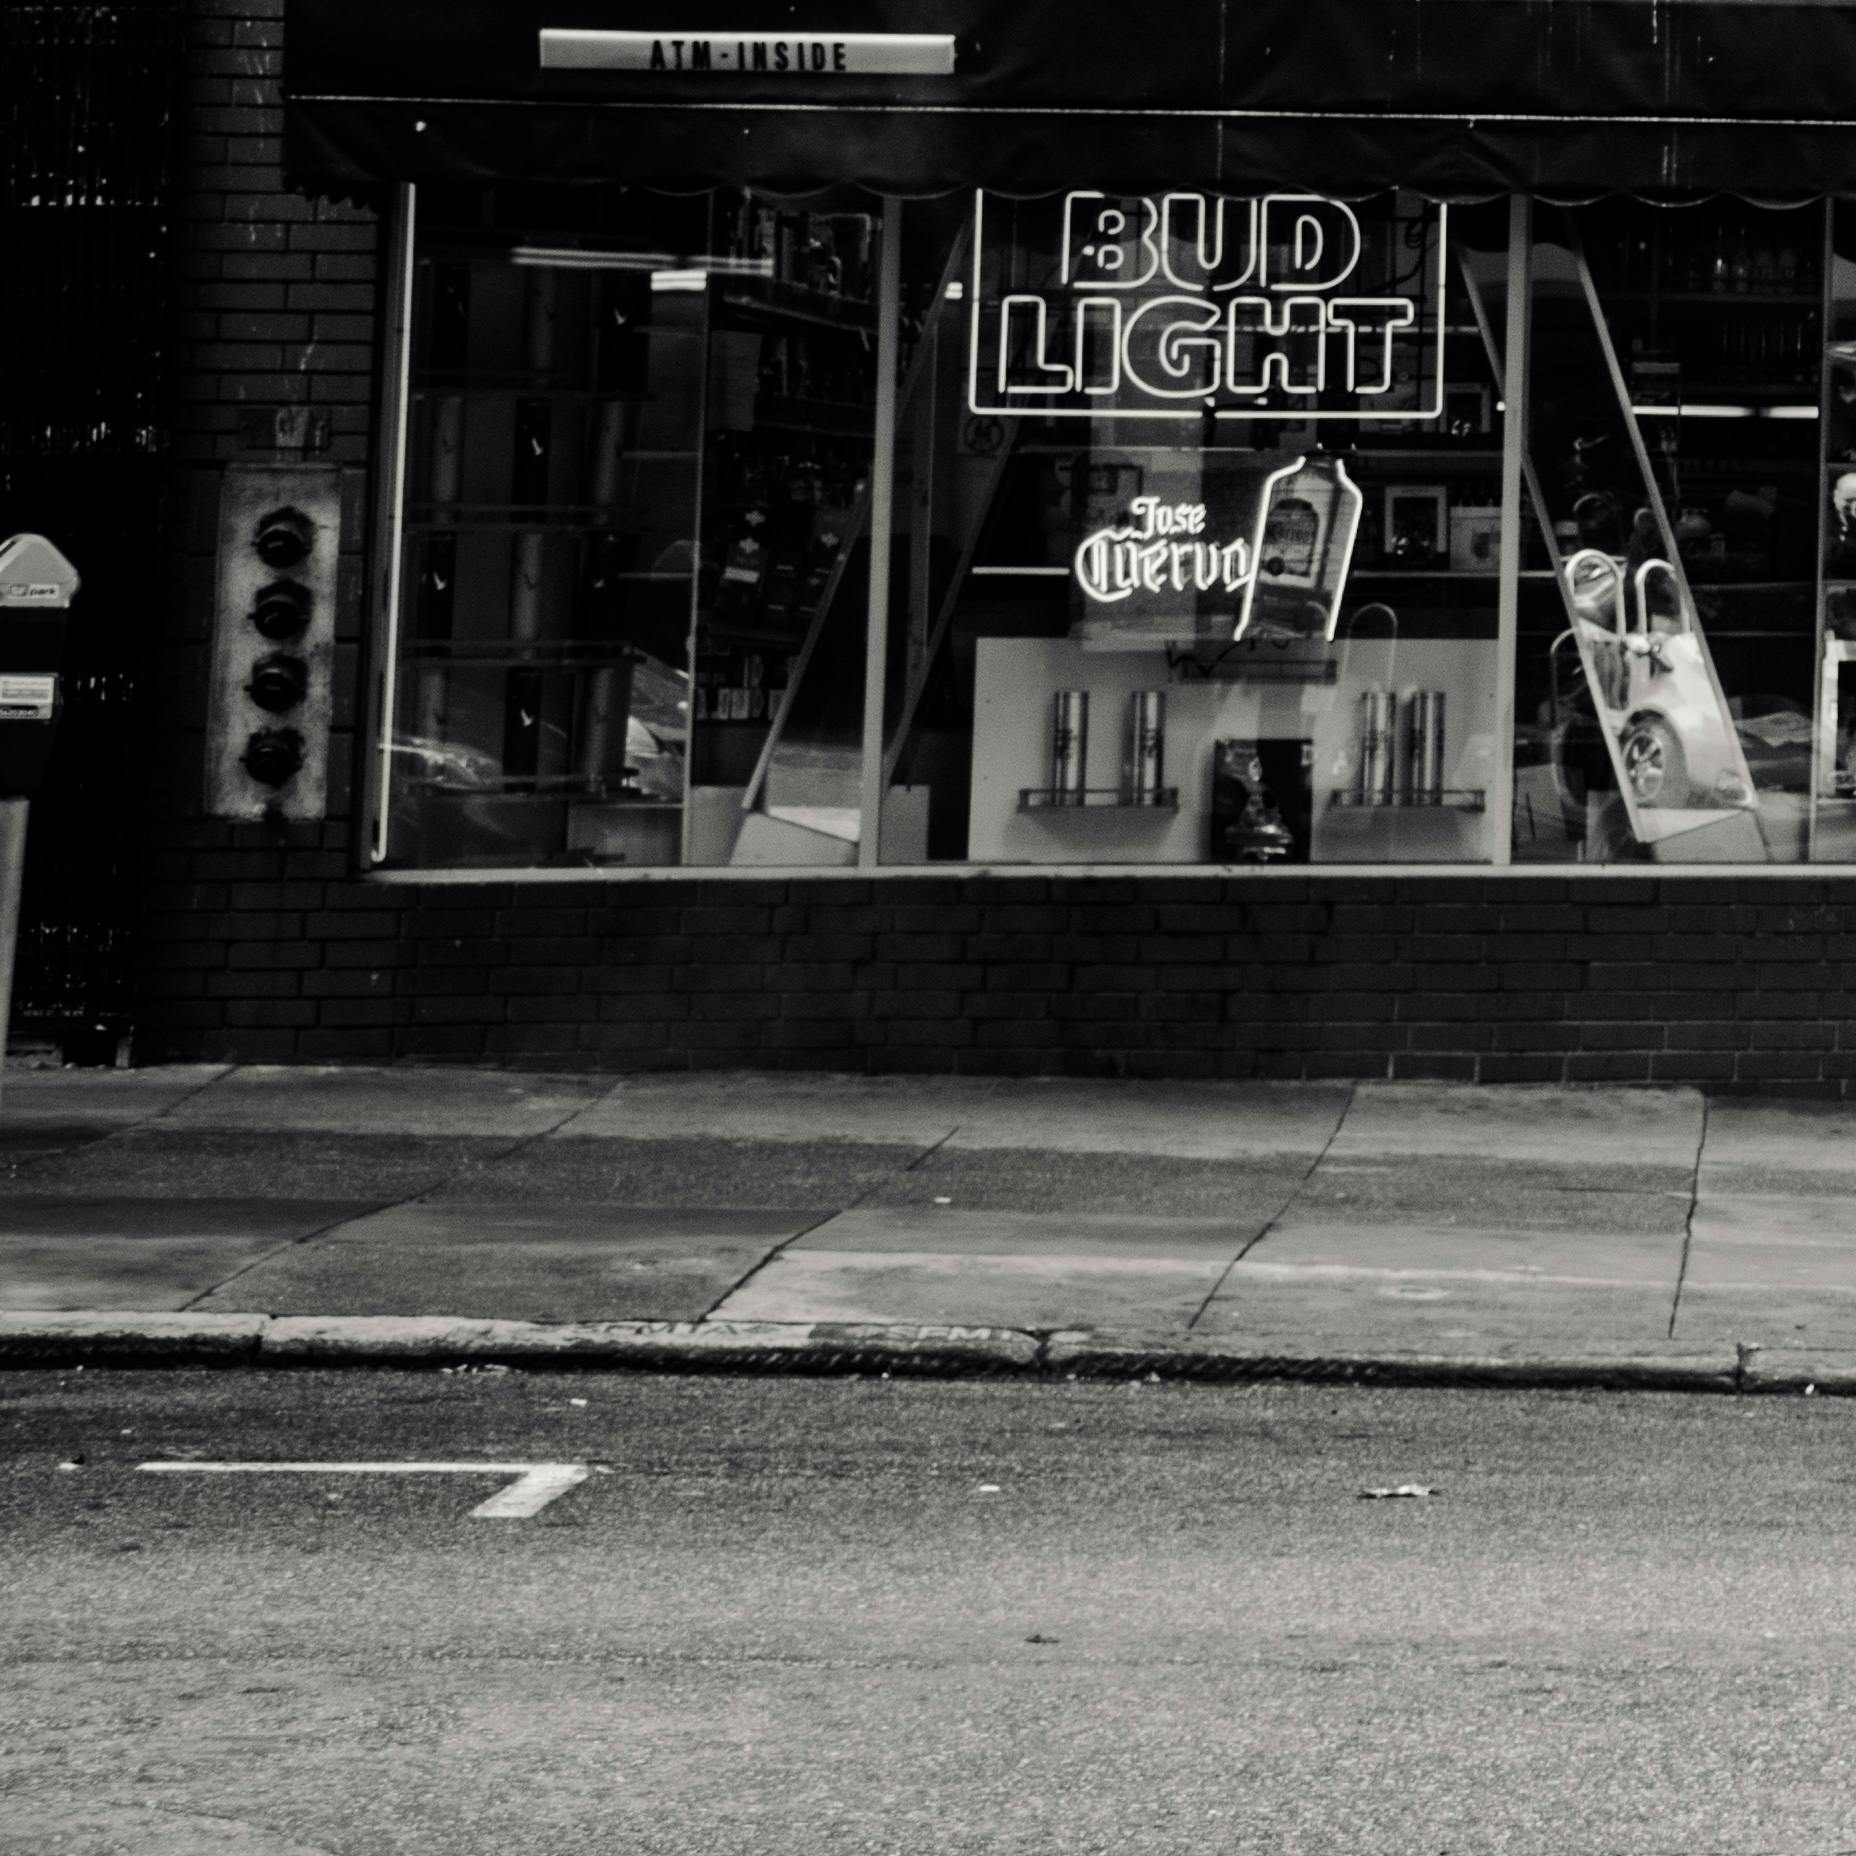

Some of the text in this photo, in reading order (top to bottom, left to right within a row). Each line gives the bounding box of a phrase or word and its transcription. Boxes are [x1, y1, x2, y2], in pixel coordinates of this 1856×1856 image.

[650, 40, 847, 73] ATM-INSIDE
[1061, 190, 1362, 292] BUD
[998, 294, 1415, 399] LIGHT
[1131, 495, 1207, 540] Jose
[1075, 528, 1254, 603] Cuervo
